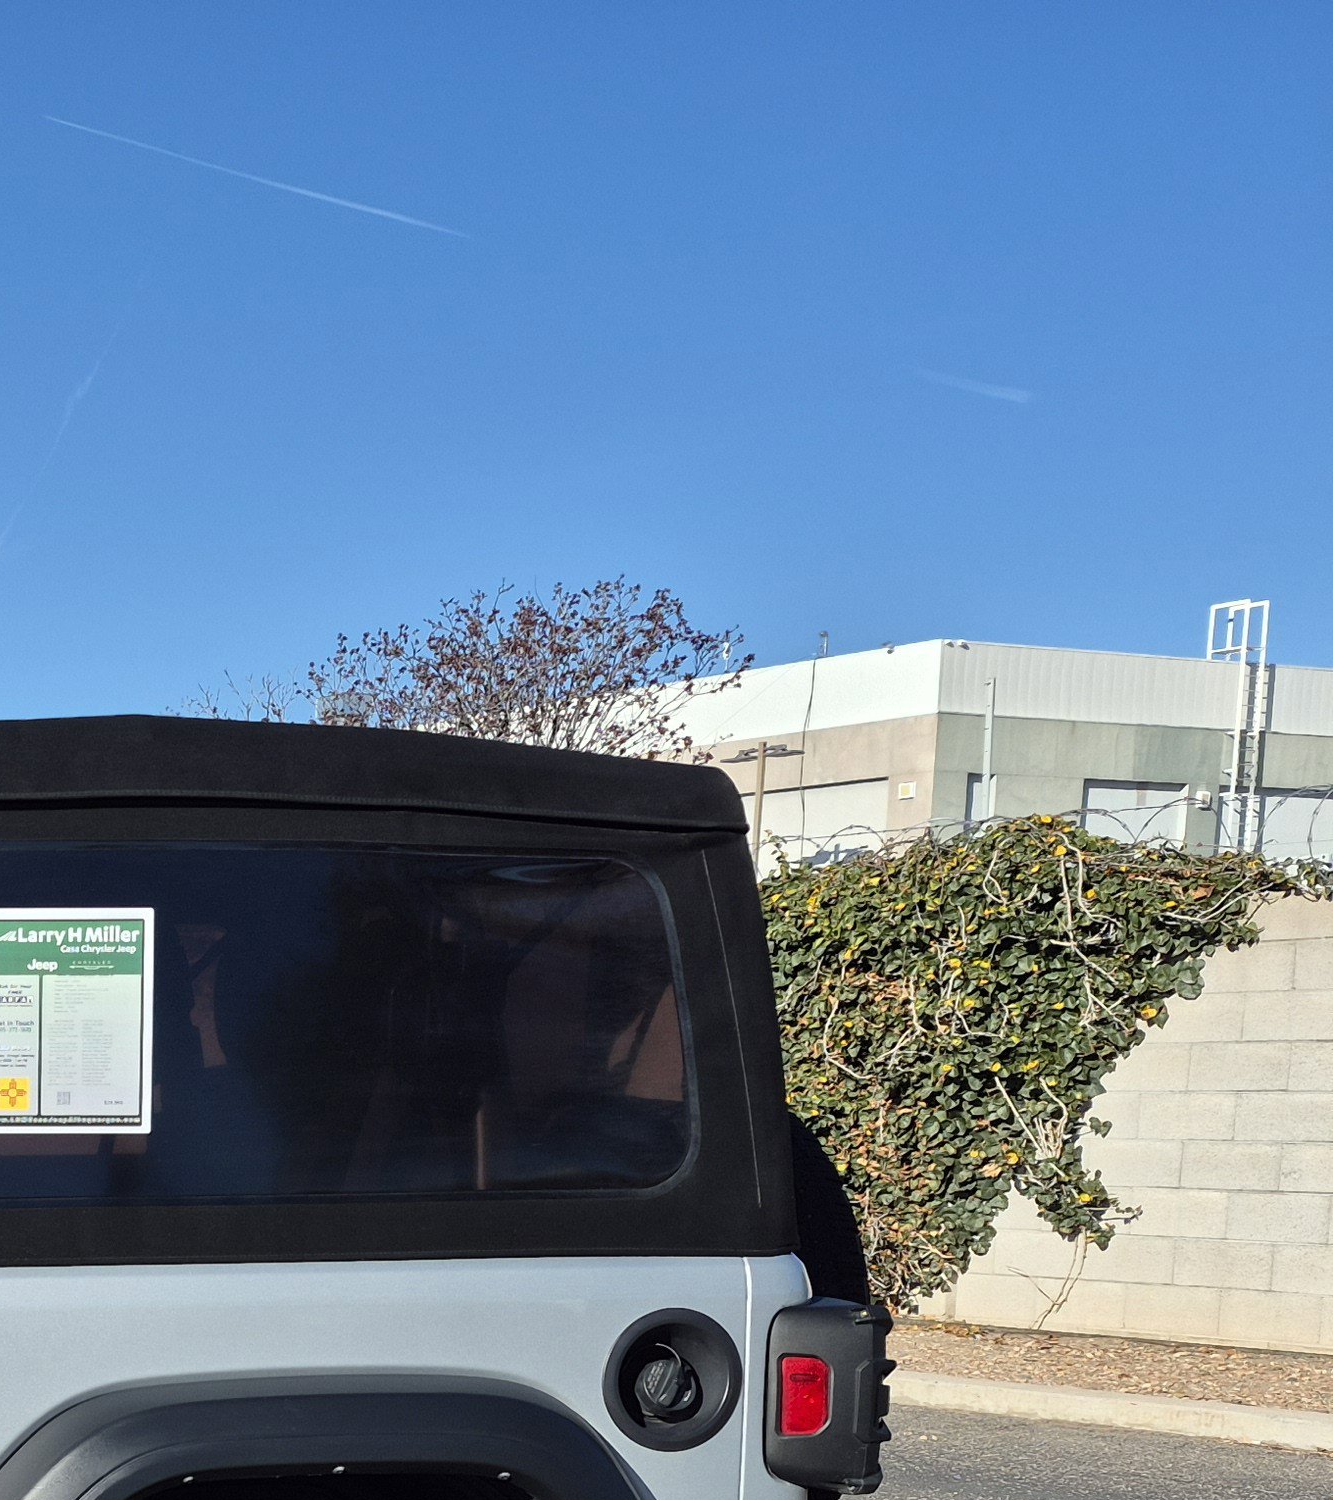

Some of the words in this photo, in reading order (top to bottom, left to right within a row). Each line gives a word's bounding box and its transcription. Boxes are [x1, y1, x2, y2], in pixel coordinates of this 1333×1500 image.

[17, 927, 66, 946] Larry
[67, 927, 83, 943] H
[85, 925, 141, 943] Miller
[60, 944, 80, 954] Casa
[81, 944, 116, 955] Chrysler
[115, 944, 138, 955] Jeep
[27, 958, 59, 972] Jeep
